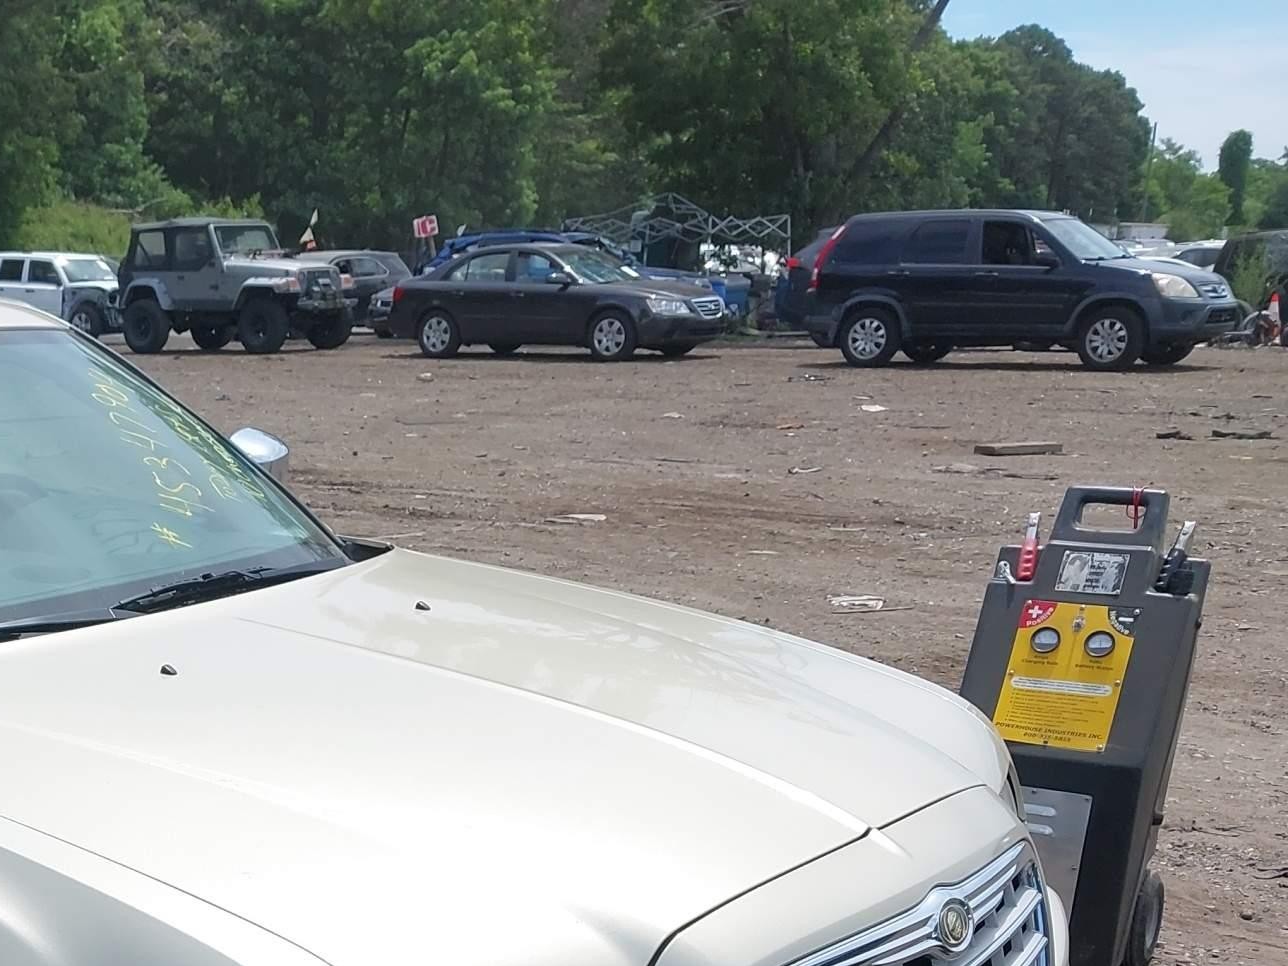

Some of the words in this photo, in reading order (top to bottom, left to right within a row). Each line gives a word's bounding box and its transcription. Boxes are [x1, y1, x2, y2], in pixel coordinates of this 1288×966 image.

[1025, 606, 1054, 627] Positive
[995, 721, 1043, 734] POWERHOUSE
[1043, 728, 1087, 740] INDUSTRIES
